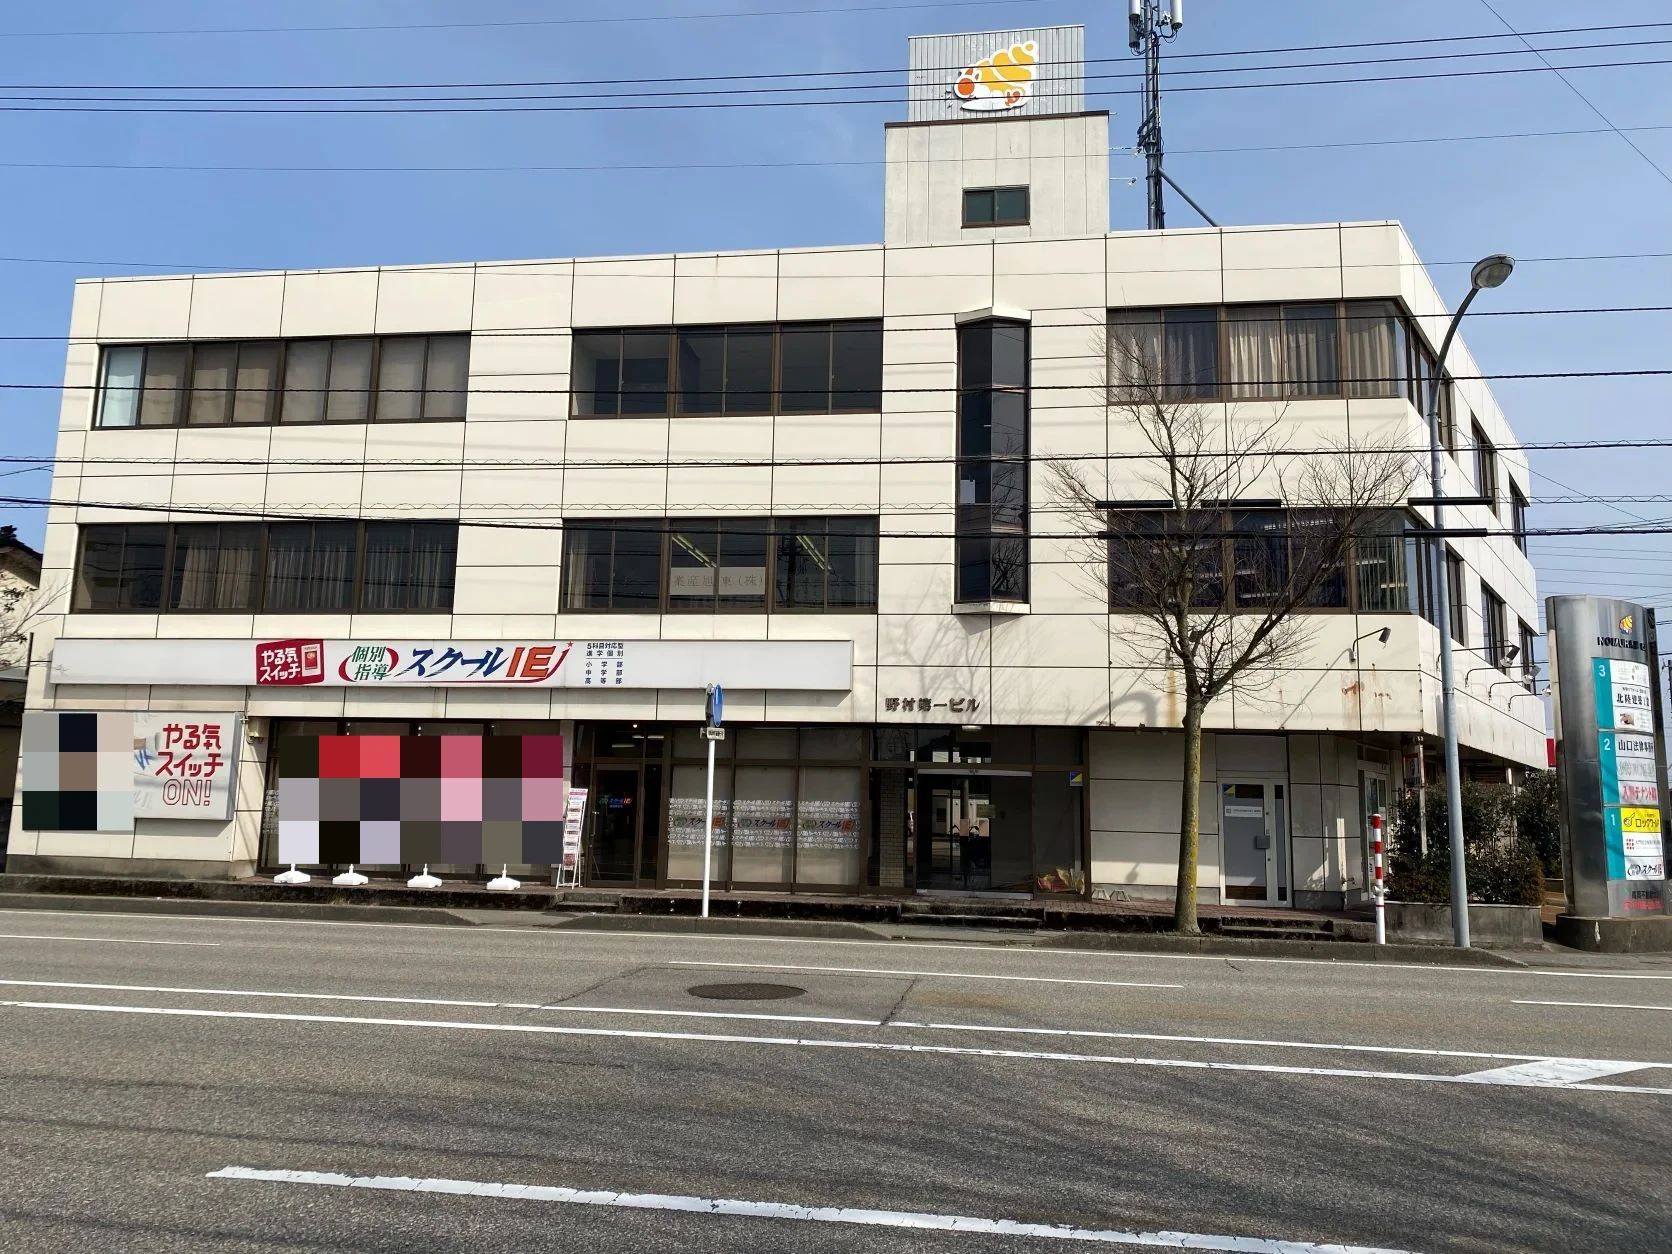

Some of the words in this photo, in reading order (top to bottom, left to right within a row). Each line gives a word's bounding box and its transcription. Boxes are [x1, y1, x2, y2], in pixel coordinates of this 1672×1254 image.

[261, 648, 299, 666] やる気
[351, 646, 387, 662] 個別
[259, 664, 301, 682] スイッチ
[353, 664, 389, 681] 指導
[1598, 664, 1606, 677] 3
[884, 697, 981, 713] 野村第一ビル
[162, 723, 222, 750] やる気
[1603, 738, 1611, 751] 2
[155, 751, 224, 777] スイッチ
[162, 778, 212, 806] ON!
[1610, 813, 1616, 826] 1
